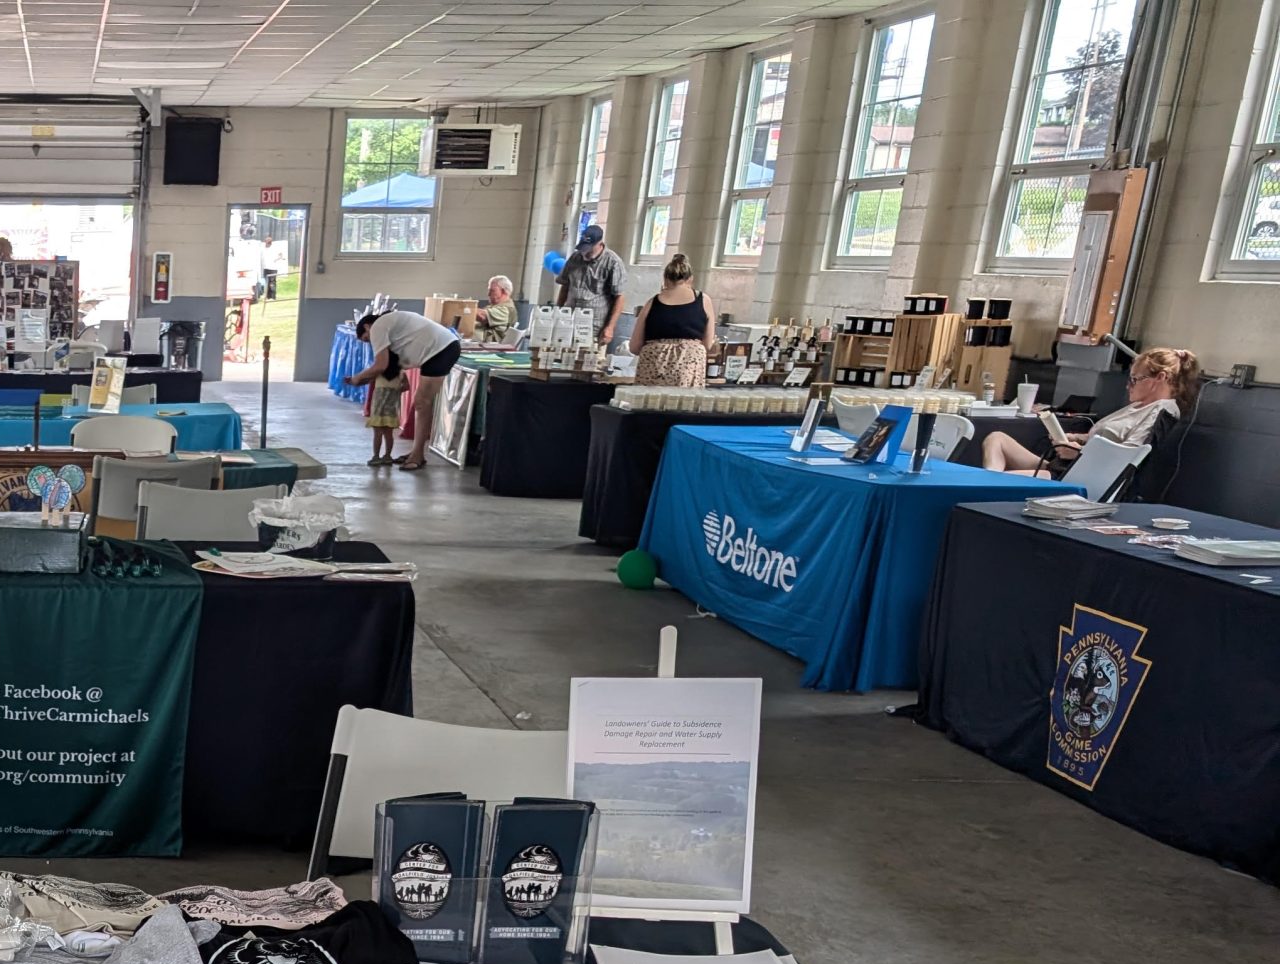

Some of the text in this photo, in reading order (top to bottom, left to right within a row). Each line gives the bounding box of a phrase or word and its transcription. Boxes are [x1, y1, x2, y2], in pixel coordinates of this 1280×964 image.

[261, 190, 280, 203] EXIT
[717, 515, 796, 592] Beltone
[1064, 632, 1128, 687] PENNSYLVANIA
[4, 684, 82, 701] Facebook
[86, 687, 103, 702] @
[605, 720, 650, 728] Landowners'
[682, 720, 722, 728] Subsidence
[604, 730, 633, 738] Damage
[699, 731, 722, 739] Supply
[1051, 722, 1107, 763] OMMSSION
[27, 751, 56, 762] our
[59, 750, 117, 765] project
[120, 750, 135, 762] at
[4, 825, 12, 833] of
[14, 826, 63, 836] Southwestern
